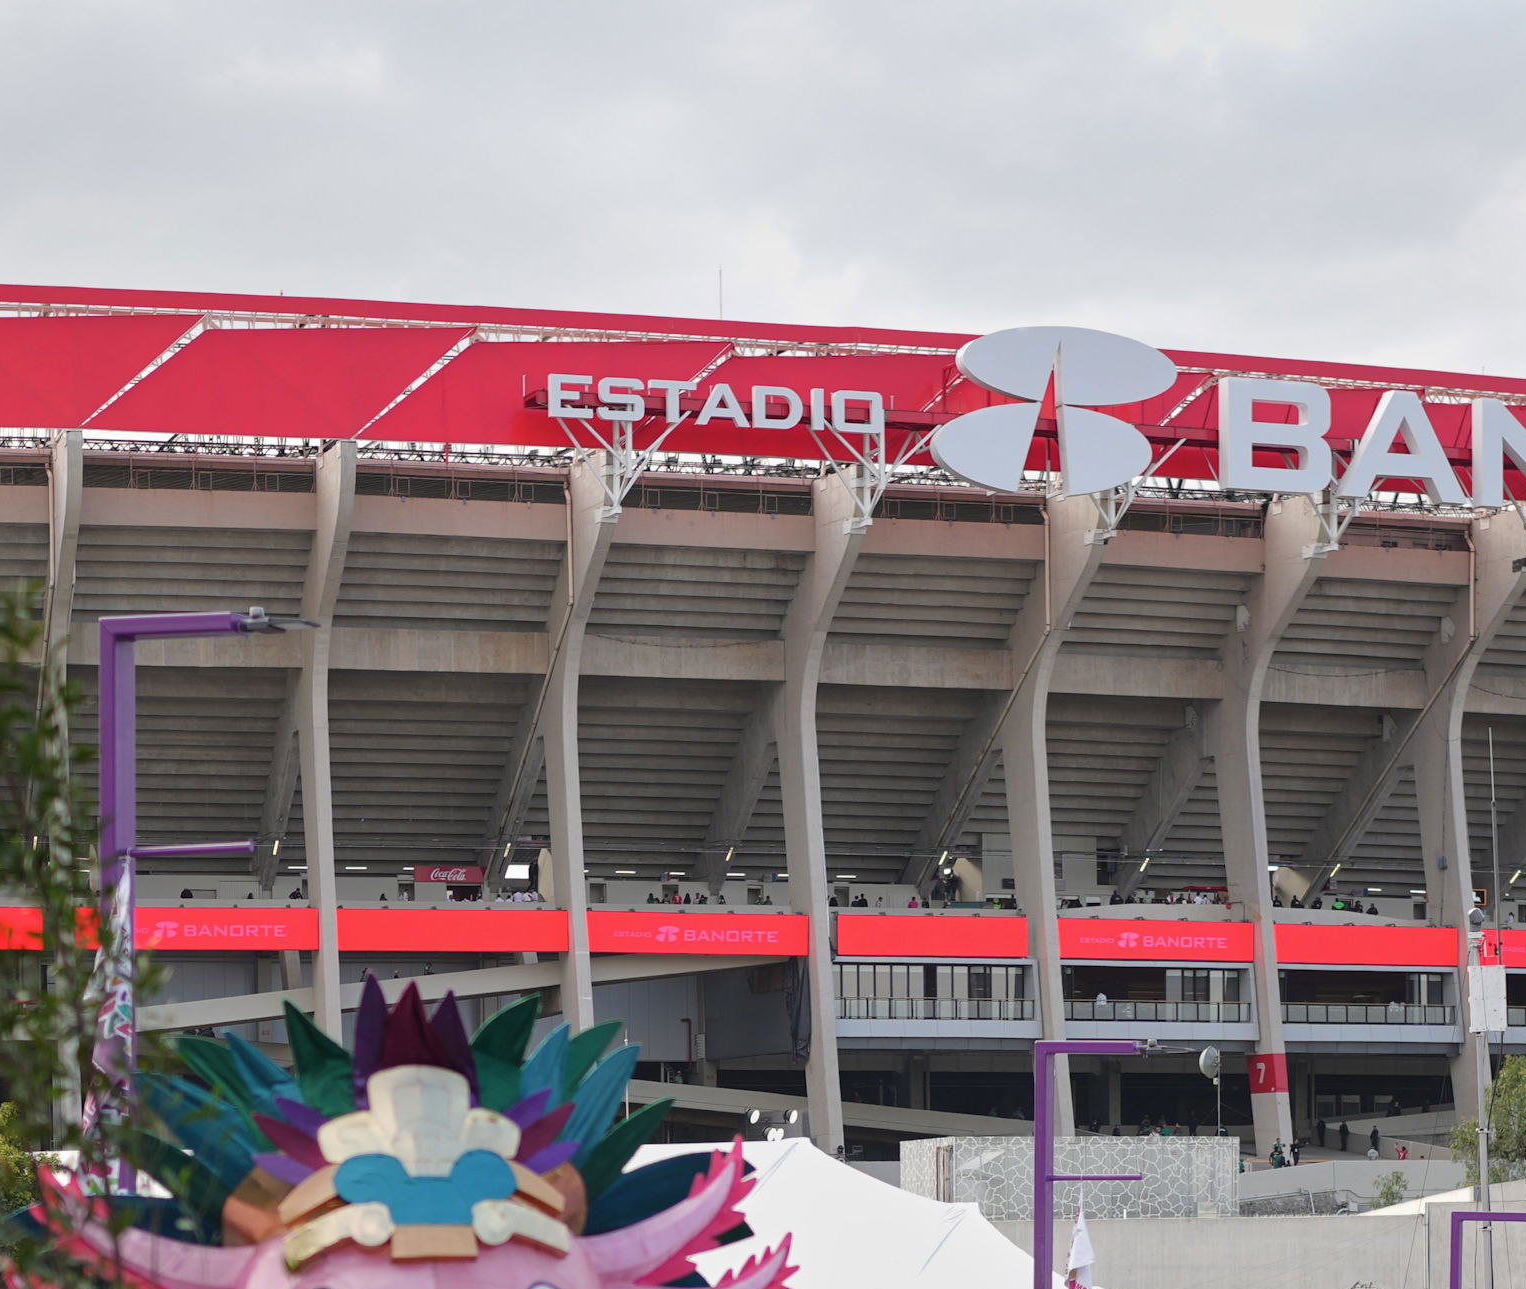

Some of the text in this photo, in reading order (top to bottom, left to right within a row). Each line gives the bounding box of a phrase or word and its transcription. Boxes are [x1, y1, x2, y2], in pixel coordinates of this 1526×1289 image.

[547, 373, 883, 434] ESTADIO
[183, 924, 287, 938] BANORTE
[613, 929, 779, 943] ESTADIO BANORTE
[1142, 935, 1228, 949] BANORTE
[1256, 1062, 1266, 1084] 7
